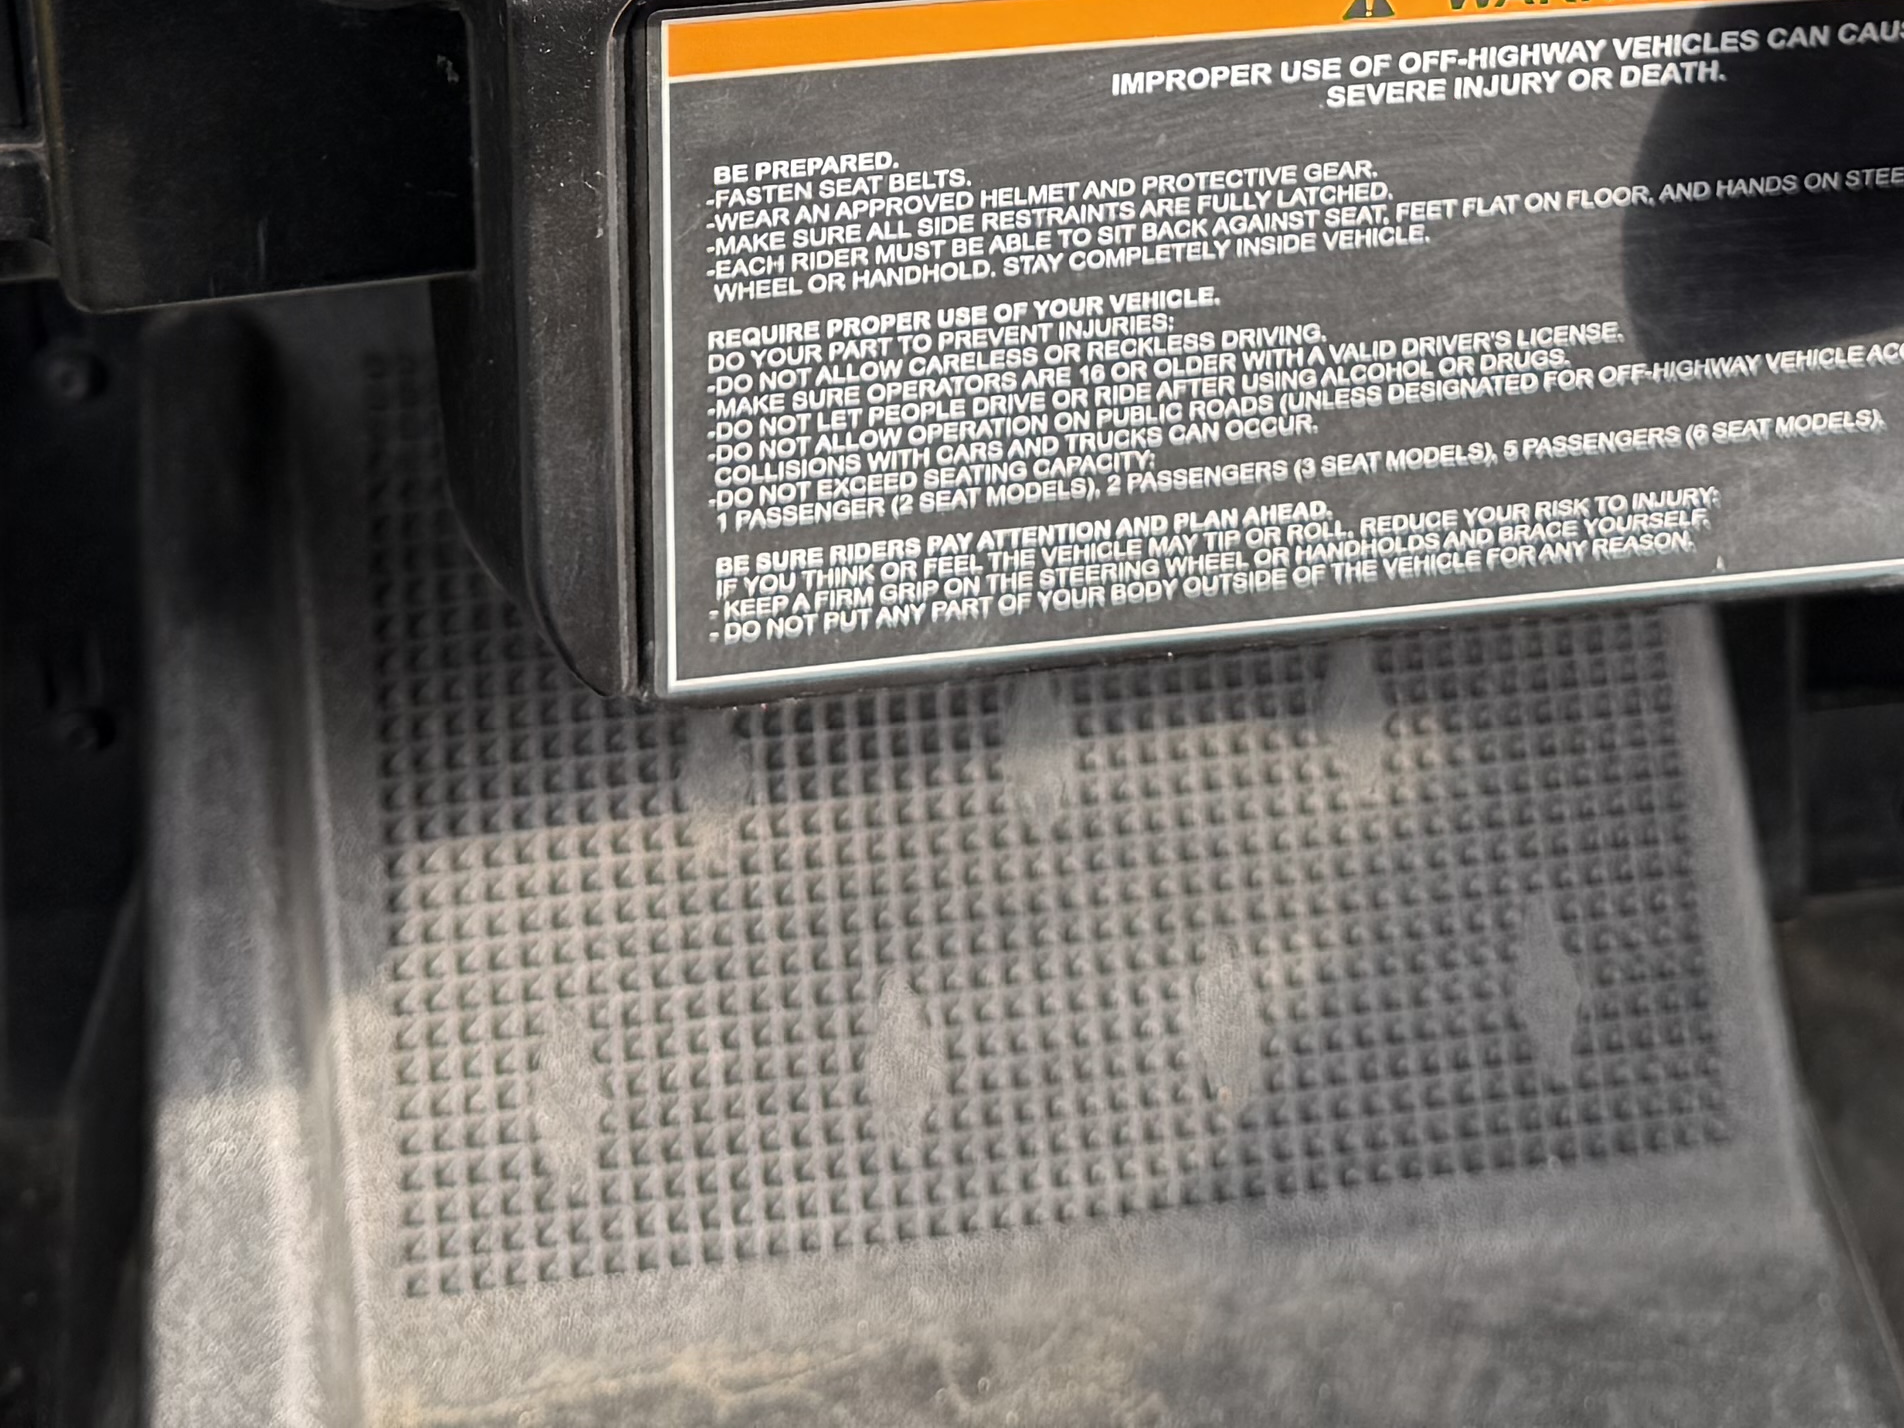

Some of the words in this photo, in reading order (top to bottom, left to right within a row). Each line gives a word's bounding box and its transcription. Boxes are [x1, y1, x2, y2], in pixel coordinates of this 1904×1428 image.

[1111, 62, 1273, 96] IMPROPER
[1280, 57, 1342, 84] USE
[1349, 53, 1393, 79] OF
[1398, 39, 1607, 75] OFF-HIGHWAY
[1612, 29, 1760, 61] VEHICLES
[1766, 25, 1830, 50] CAN
[1326, 78, 1447, 109] SEVERE
[1453, 70, 1563, 100] INJURY
[1567, 67, 1613, 92] OR
[1619, 59, 1727, 88] DEATH.
[705, 207, 790, 232] -WEAR
[794, 203, 830, 225] AN
[834, 191, 975, 221] APPROVED
[980, 182, 1081, 209] HELMET
[1082, 178, 1136, 200] AND
[1141, 165, 1298, 196] PROTECTIVE
[1303, 159, 1378, 183] GEAR.
[713, 164, 749, 185] BE
[755, 151, 900, 182] PREPARED.
[707, 320, 821, 351] REQUIRE
[826, 310, 932, 340] PROPER
[937, 305, 988, 329] USE
[993, 301, 1029, 323] OF
[1032, 295, 1104, 321] YOUR
[1108, 286, 1221, 314] VEHICLE.
[715, 554, 750, 578] BE
[755, 546, 824, 576] SURE
[829, 537, 922, 570] RIDERS
[926, 532, 974, 560] PAY
[976, 519, 1112, 554] ATTENTION
[1115, 514, 1169, 542] AND
[1173, 508, 1239, 536] PLAN
[1242, 500, 1333, 528] AHEAD.
